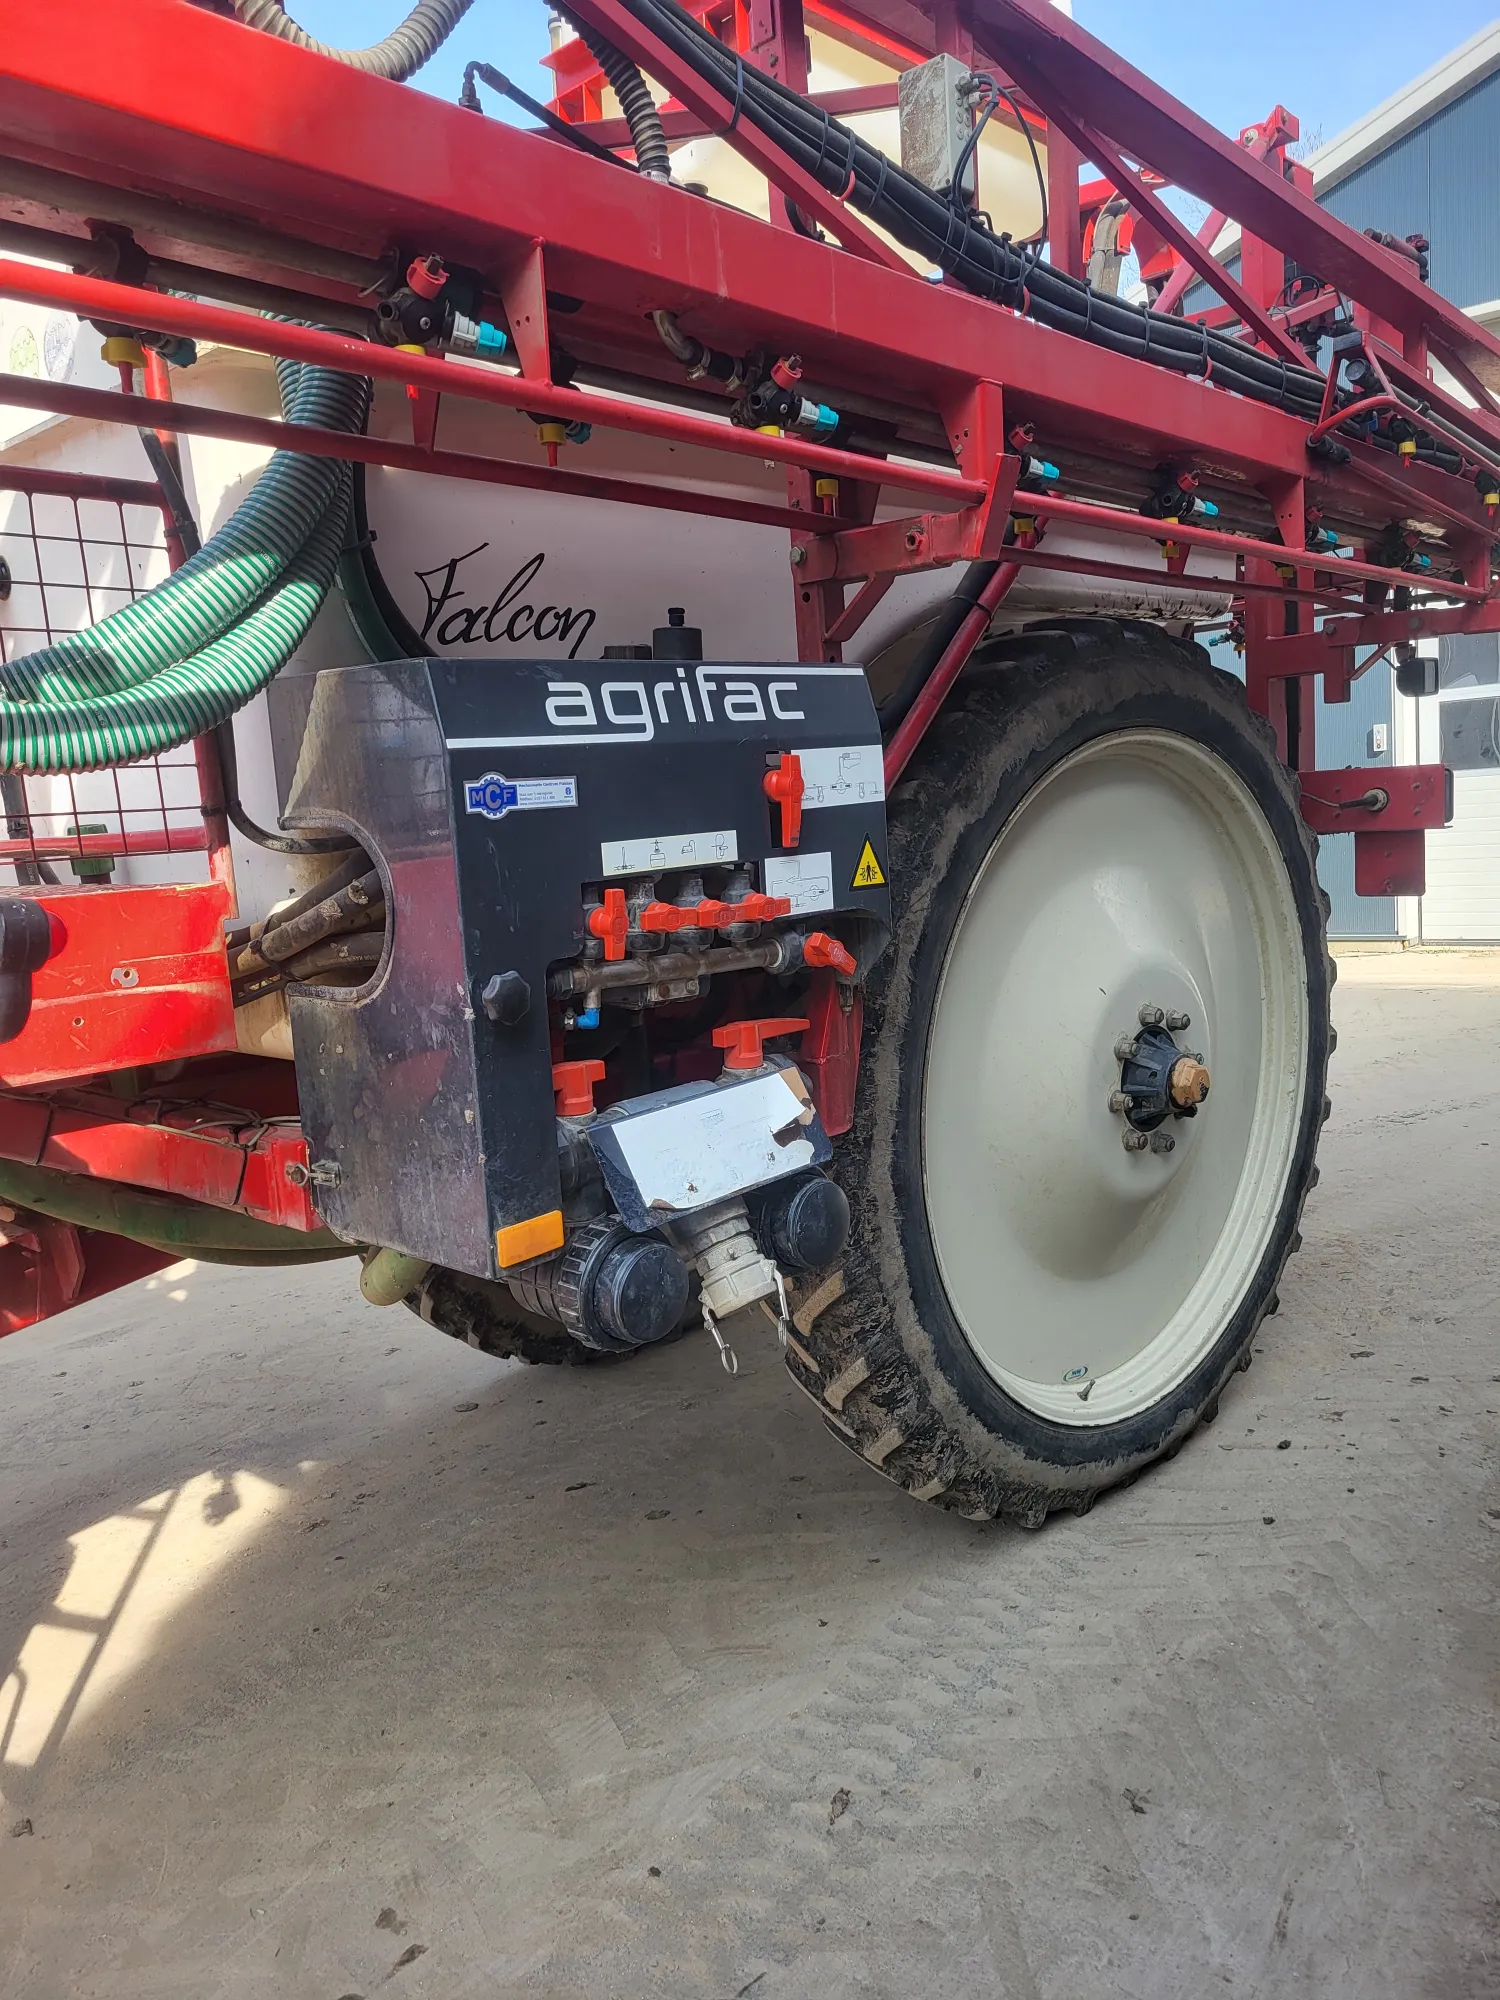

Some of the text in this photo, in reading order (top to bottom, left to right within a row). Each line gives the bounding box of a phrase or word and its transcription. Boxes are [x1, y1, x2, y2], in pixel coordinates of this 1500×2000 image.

[414, 542, 597, 659] Falcon
[544, 666, 806, 742] agrifac
[472, 784, 514, 809] MCF
